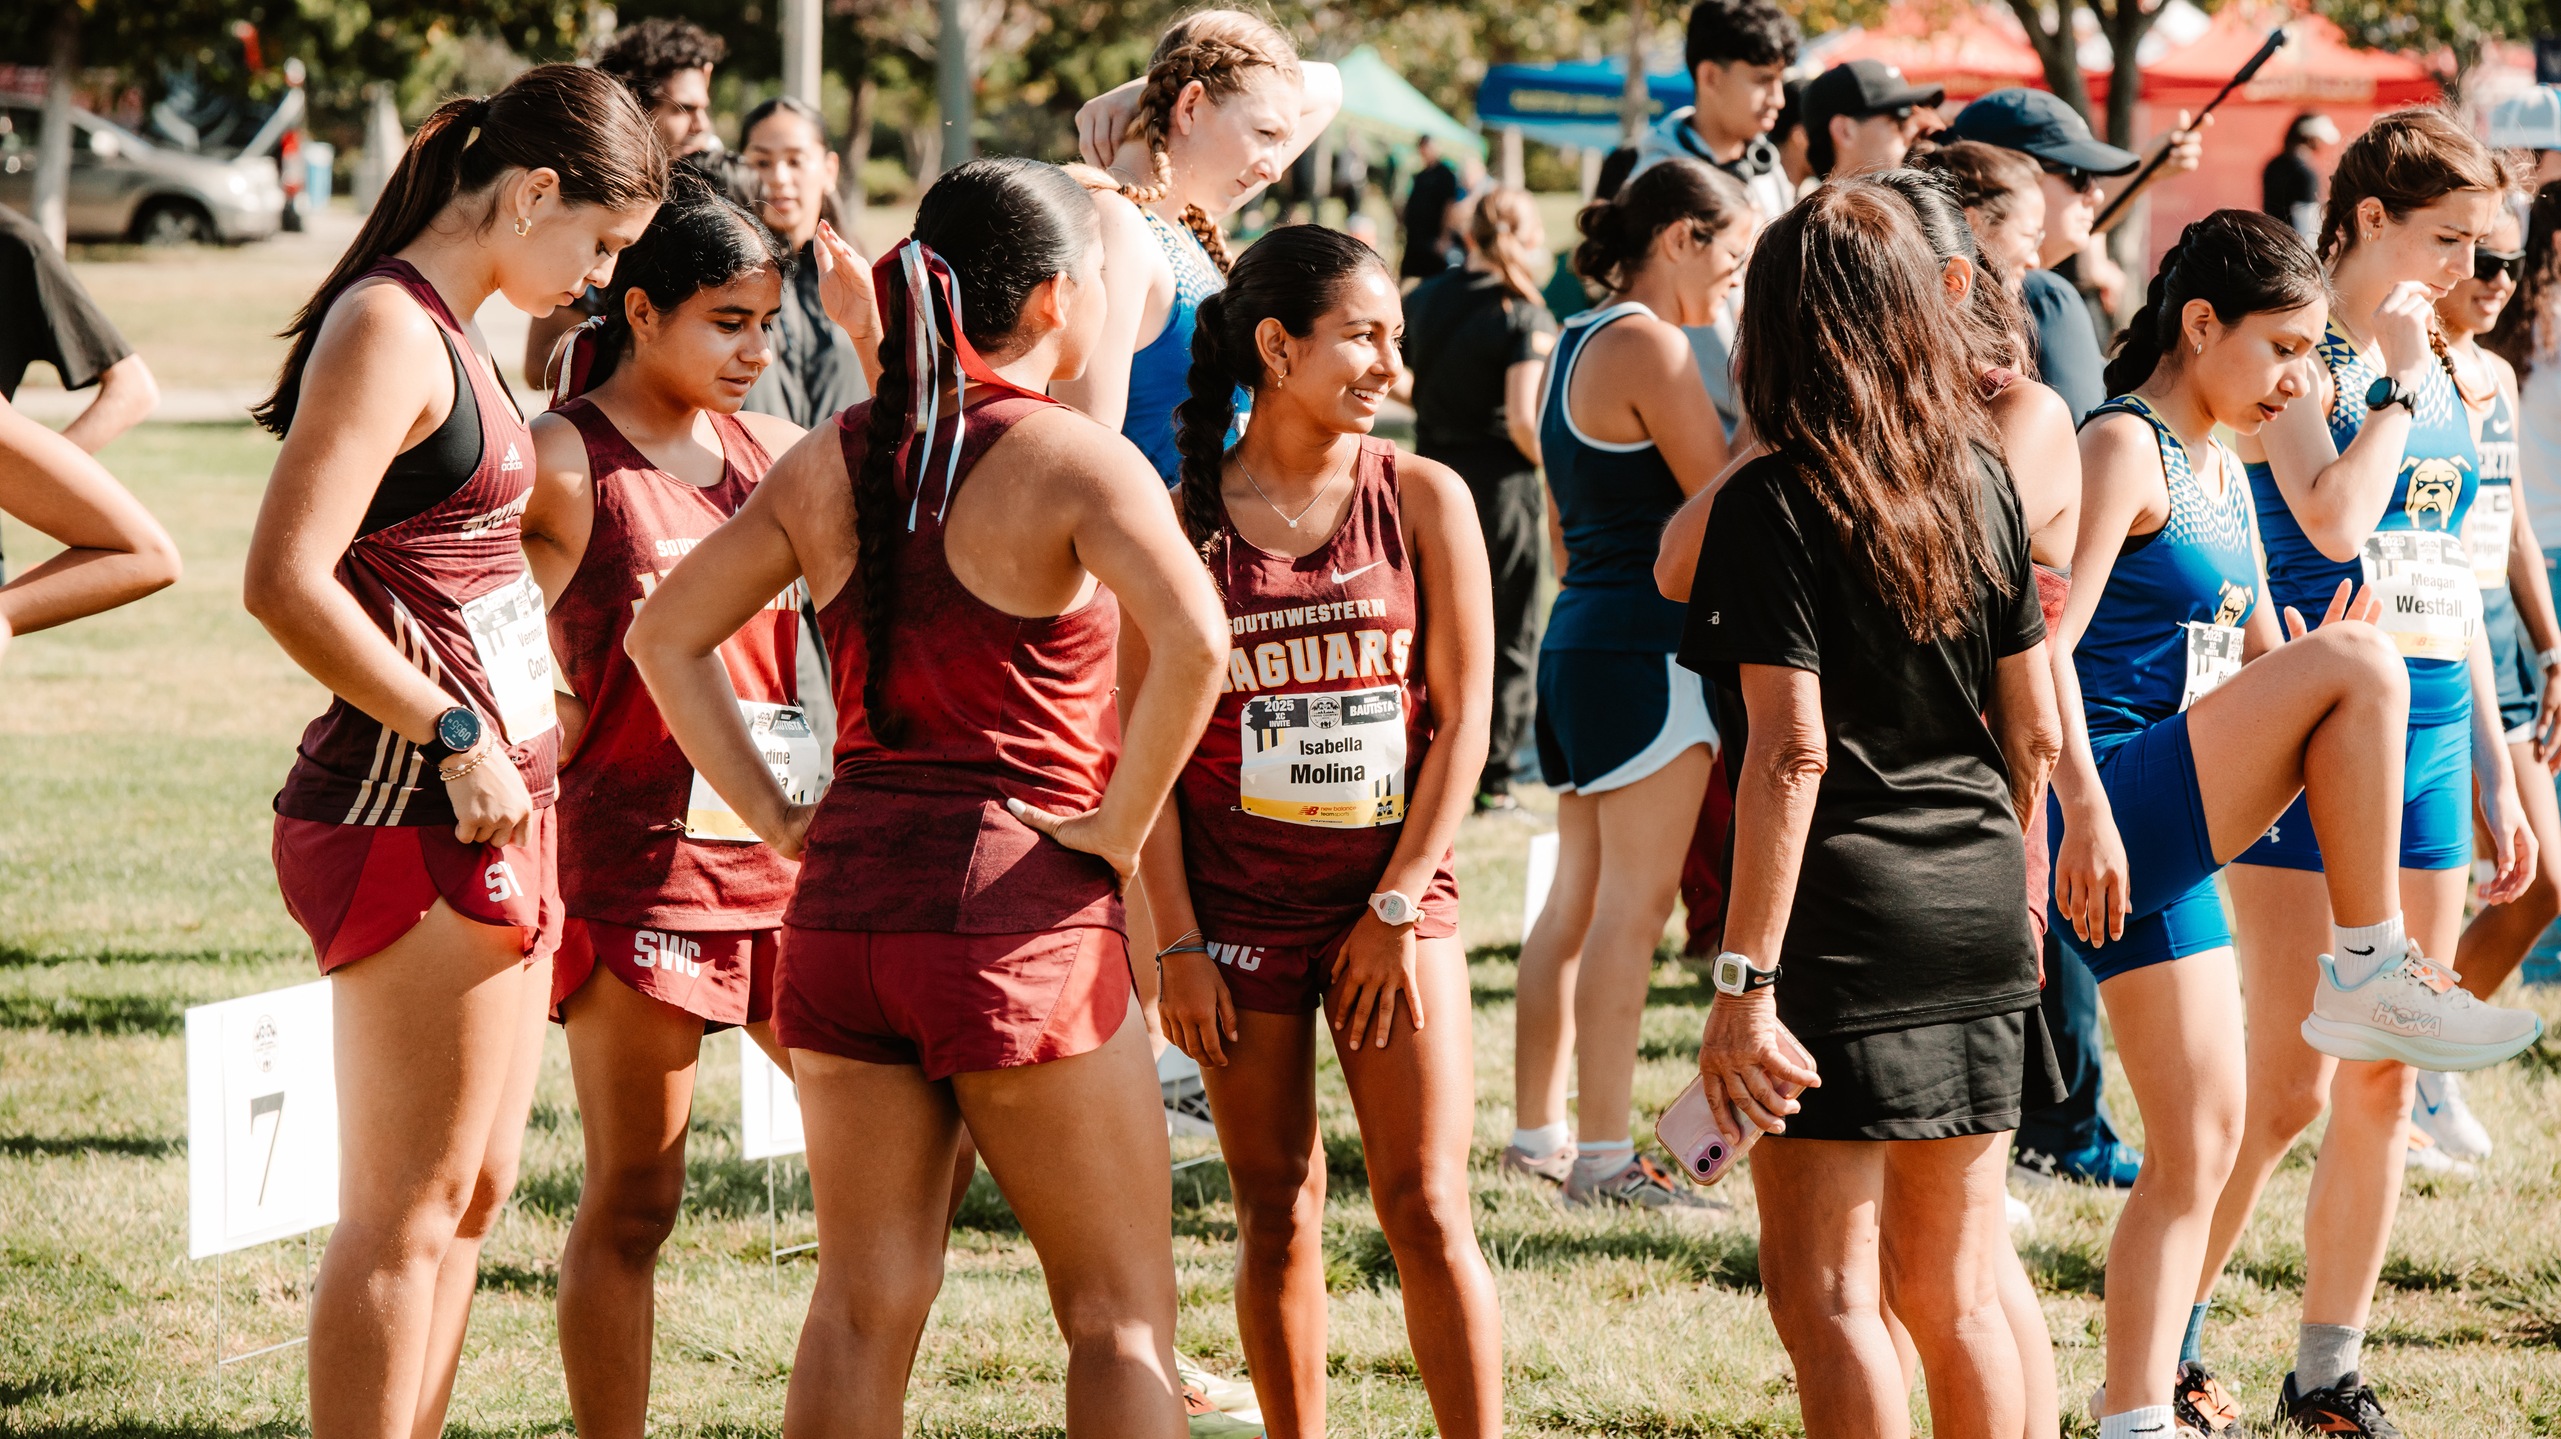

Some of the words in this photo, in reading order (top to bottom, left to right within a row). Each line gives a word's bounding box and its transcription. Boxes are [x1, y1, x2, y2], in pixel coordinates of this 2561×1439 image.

[501, 461, 523, 471] adidas
[2411, 573, 2456, 591] Meagan
[2396, 595, 2463, 618] Westfall
[2202, 630, 2224, 643] 2025
[1219, 628, 1414, 694] AGUARS
[1264, 700, 1295, 712] 2025
[1349, 700, 1395, 717] BAUTISTA
[1269, 720, 1291, 728] INVITE
[1275, 712, 1286, 720] XC
[1299, 737, 1363, 756] Isabella
[1290, 763, 1366, 785] Molina
[633, 930, 701, 979] SWC
[2371, 1003, 2443, 1038] HOKA
[250, 1090, 286, 1207] 7
